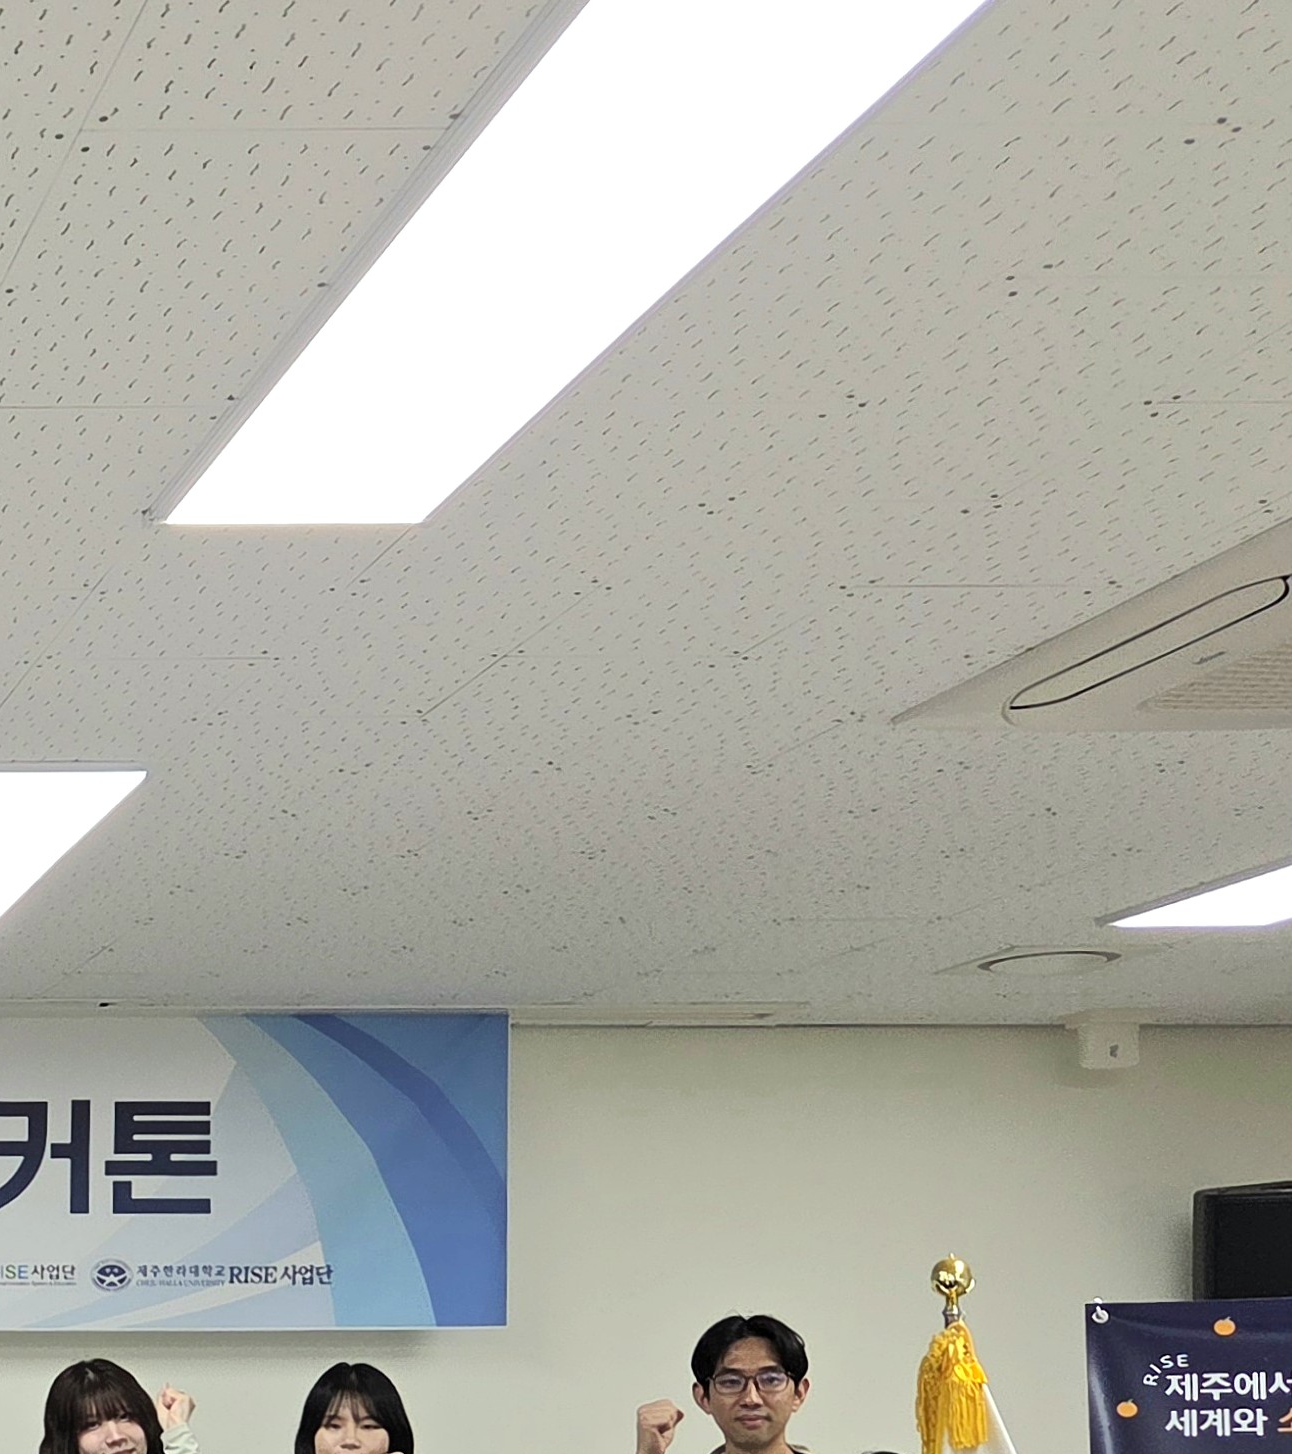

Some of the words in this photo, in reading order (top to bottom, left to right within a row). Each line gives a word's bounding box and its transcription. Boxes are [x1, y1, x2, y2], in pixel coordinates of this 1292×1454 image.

[229, 1265, 277, 1284] RISE
[280, 1264, 334, 1285] 사업단
[1143, 1354, 1189, 1386] RISE
[1165, 1408, 1268, 1437] 세계와
